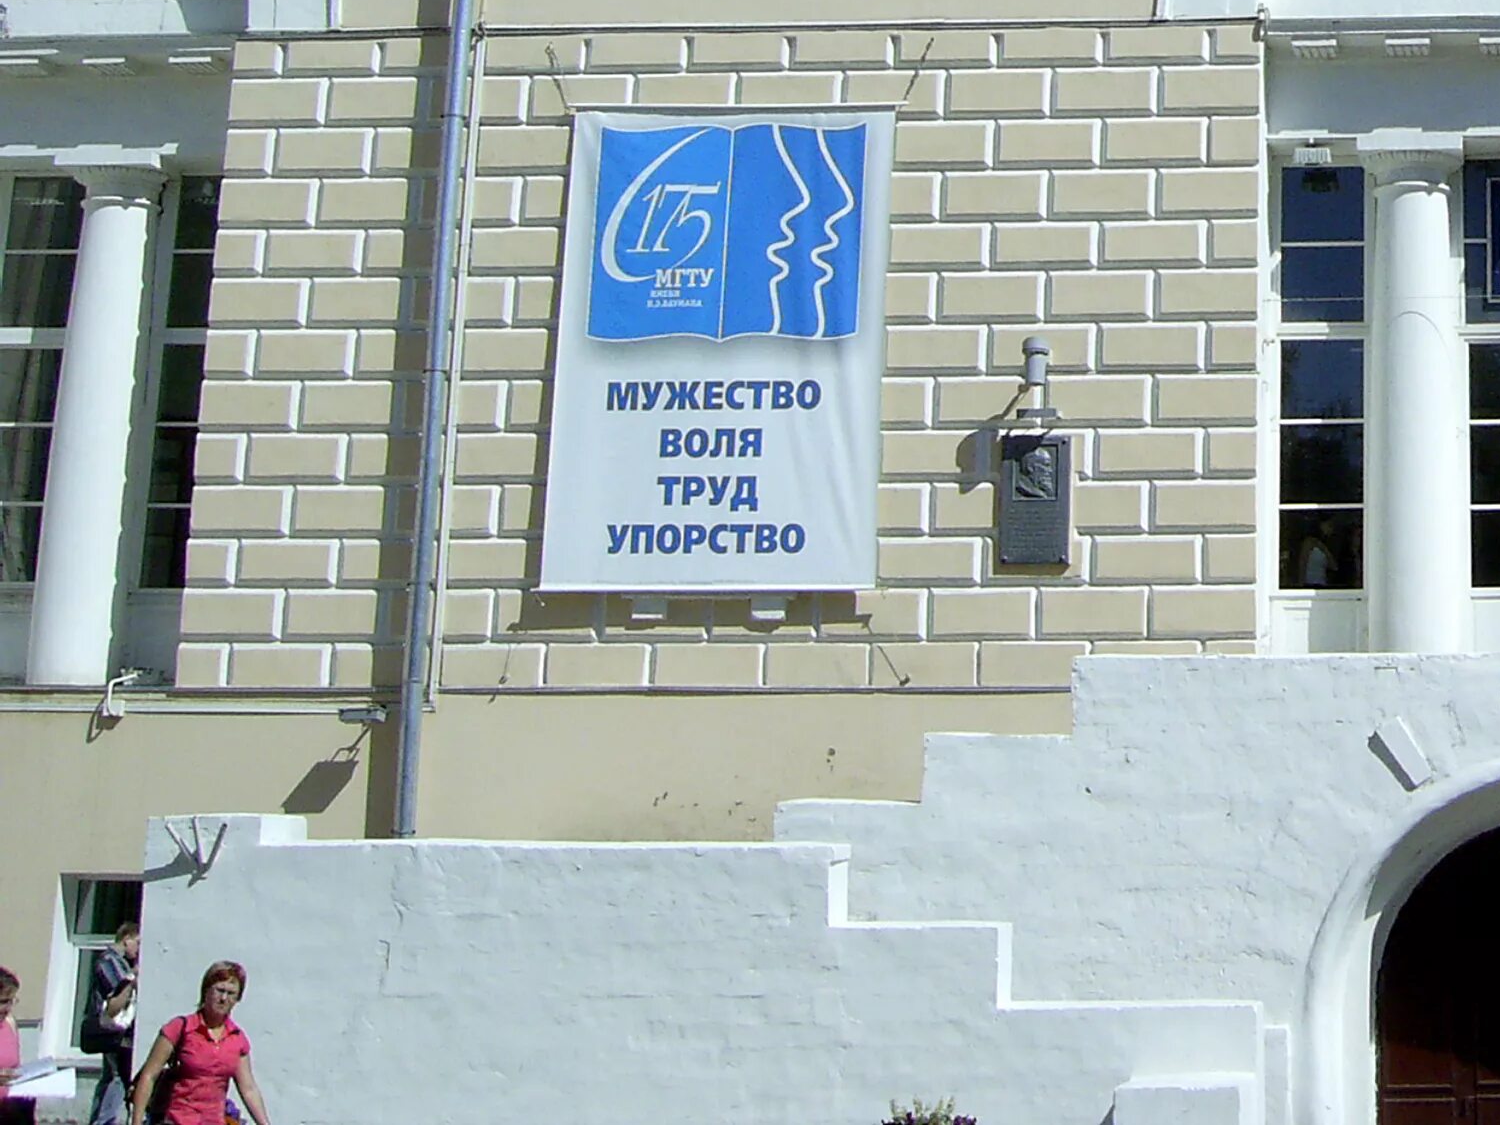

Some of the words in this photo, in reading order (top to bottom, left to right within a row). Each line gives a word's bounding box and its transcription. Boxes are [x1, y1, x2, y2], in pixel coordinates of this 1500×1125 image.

[626, 181, 721, 268] 175
[655, 268, 715, 288] МГТУ
[606, 379, 821, 411] МУЖЕСТВО
[659, 428, 763, 458] ВОЛЯ
[657, 476, 759, 512] ТРУД
[607, 523, 806, 555] УПОРСТВО
